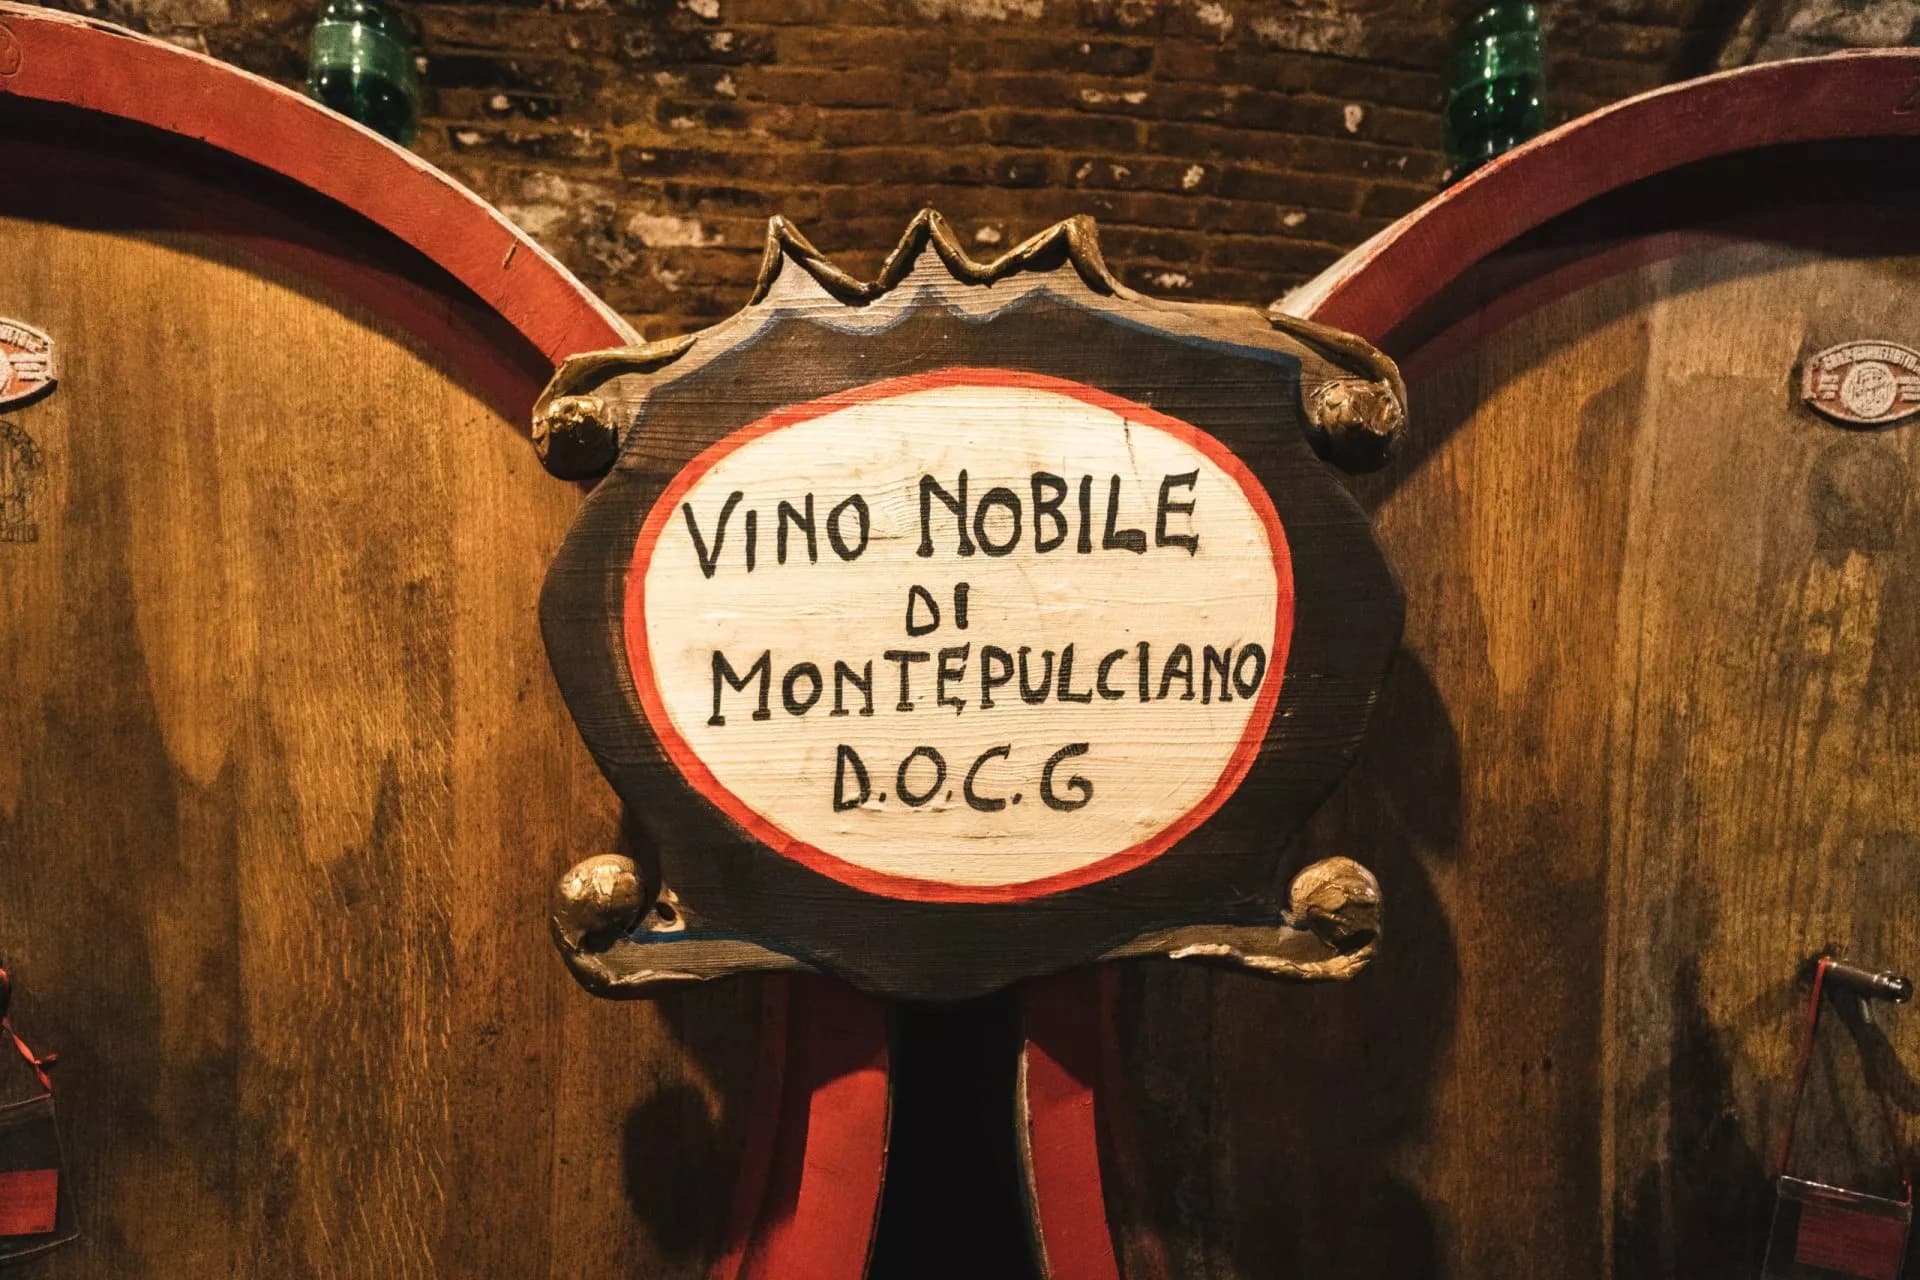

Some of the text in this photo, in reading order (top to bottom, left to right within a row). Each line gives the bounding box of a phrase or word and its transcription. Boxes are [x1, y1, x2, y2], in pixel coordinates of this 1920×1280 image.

[682, 469, 1199, 578] VINO NOBILE
[906, 583, 969, 637] DI
[708, 642, 1266, 726] MONTEPULCIANO
[833, 743, 1093, 812] D.O.C.G
